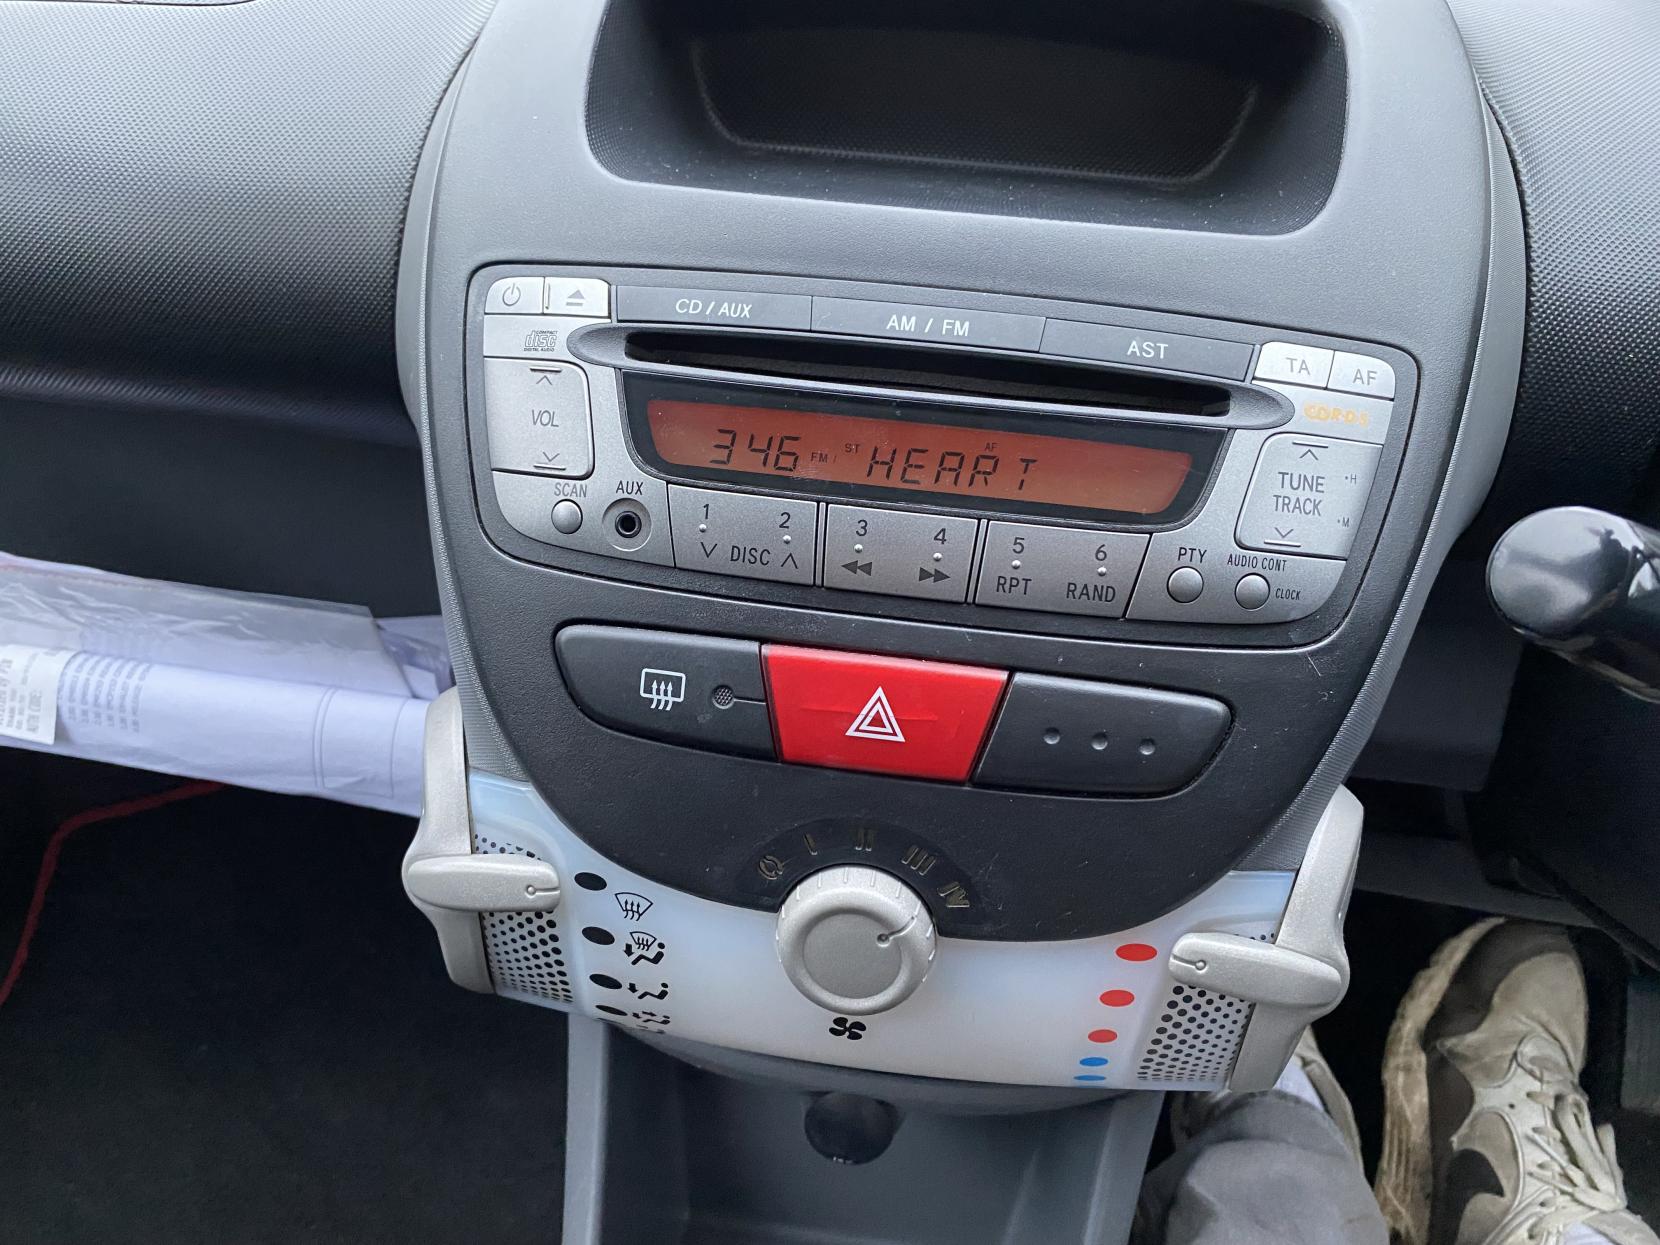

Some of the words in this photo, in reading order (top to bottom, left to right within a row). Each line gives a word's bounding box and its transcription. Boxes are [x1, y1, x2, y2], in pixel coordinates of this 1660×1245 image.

[675, 298, 702, 314] CD
[719, 302, 752, 318] AUX
[886, 314, 915, 332] AM
[941, 319, 970, 337] FM
[1127, 340, 1169, 360] AST
[1286, 357, 1311, 376] TA
[1353, 368, 1378, 387] AF
[532, 409, 560, 428] VOL
[710, 429, 801, 472] 346
[844, 442, 861, 455] ST
[984, 442, 998, 452] AF
[867, 445, 1038, 491] HEART
[554, 482, 588, 499] SCAN
[615, 480, 644, 496] AUX
[1278, 471, 1325, 493] TUNE
[702, 503, 710, 520] 1
[1273, 495, 1322, 517] TRACK
[778, 512, 791, 529] 2
[855, 519, 868, 537] 3
[933, 528, 947, 545] 4
[1012, 537, 1025, 554] 5
[730, 546, 771, 566] DISC
[1095, 544, 1107, 561] 6
[1178, 547, 1207, 563] PTY
[1227, 554, 1258, 569] AUDIO
[1262, 557, 1287, 572] CONT
[996, 575, 1032, 596] RPT
[1066, 582, 1116, 603] RAND
[1275, 588, 1301, 601] CLOCK
